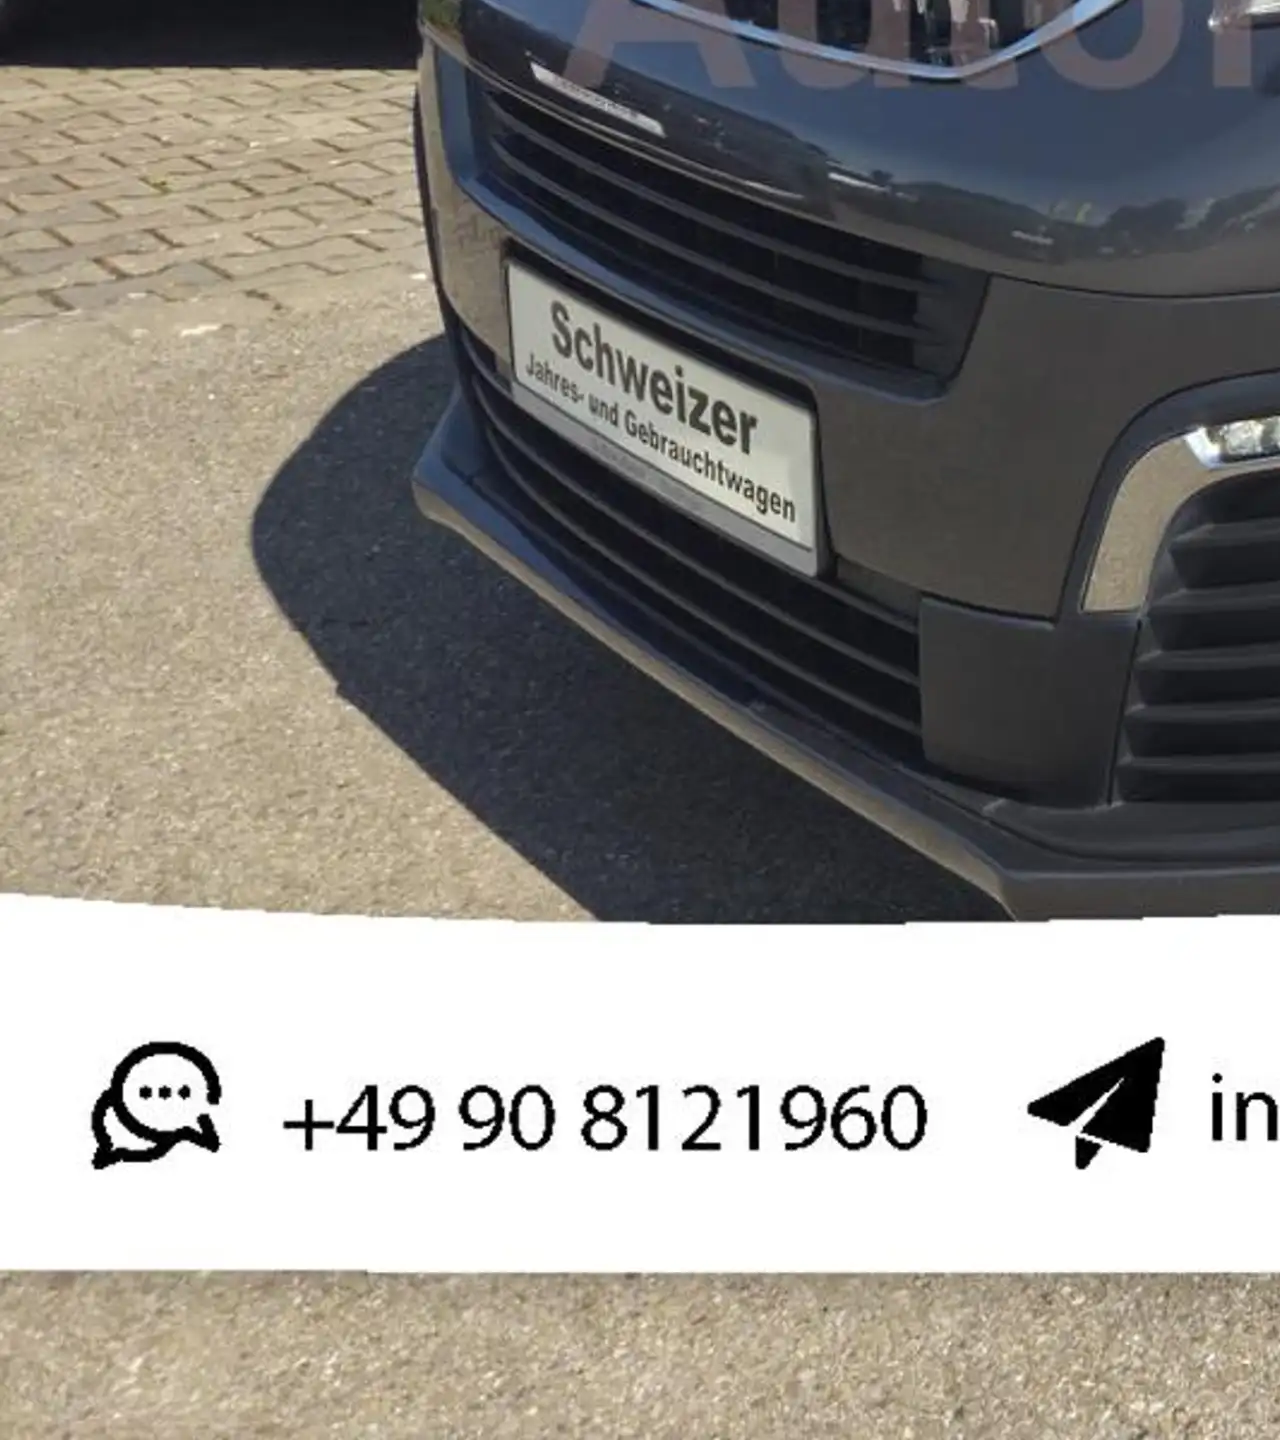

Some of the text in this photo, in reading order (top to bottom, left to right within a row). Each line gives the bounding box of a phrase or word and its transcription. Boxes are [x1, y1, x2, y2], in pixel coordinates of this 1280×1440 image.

[525, 353, 796, 523] Jahres- und Gebrauchtwagen
[550, 300, 759, 455] Schweizer
